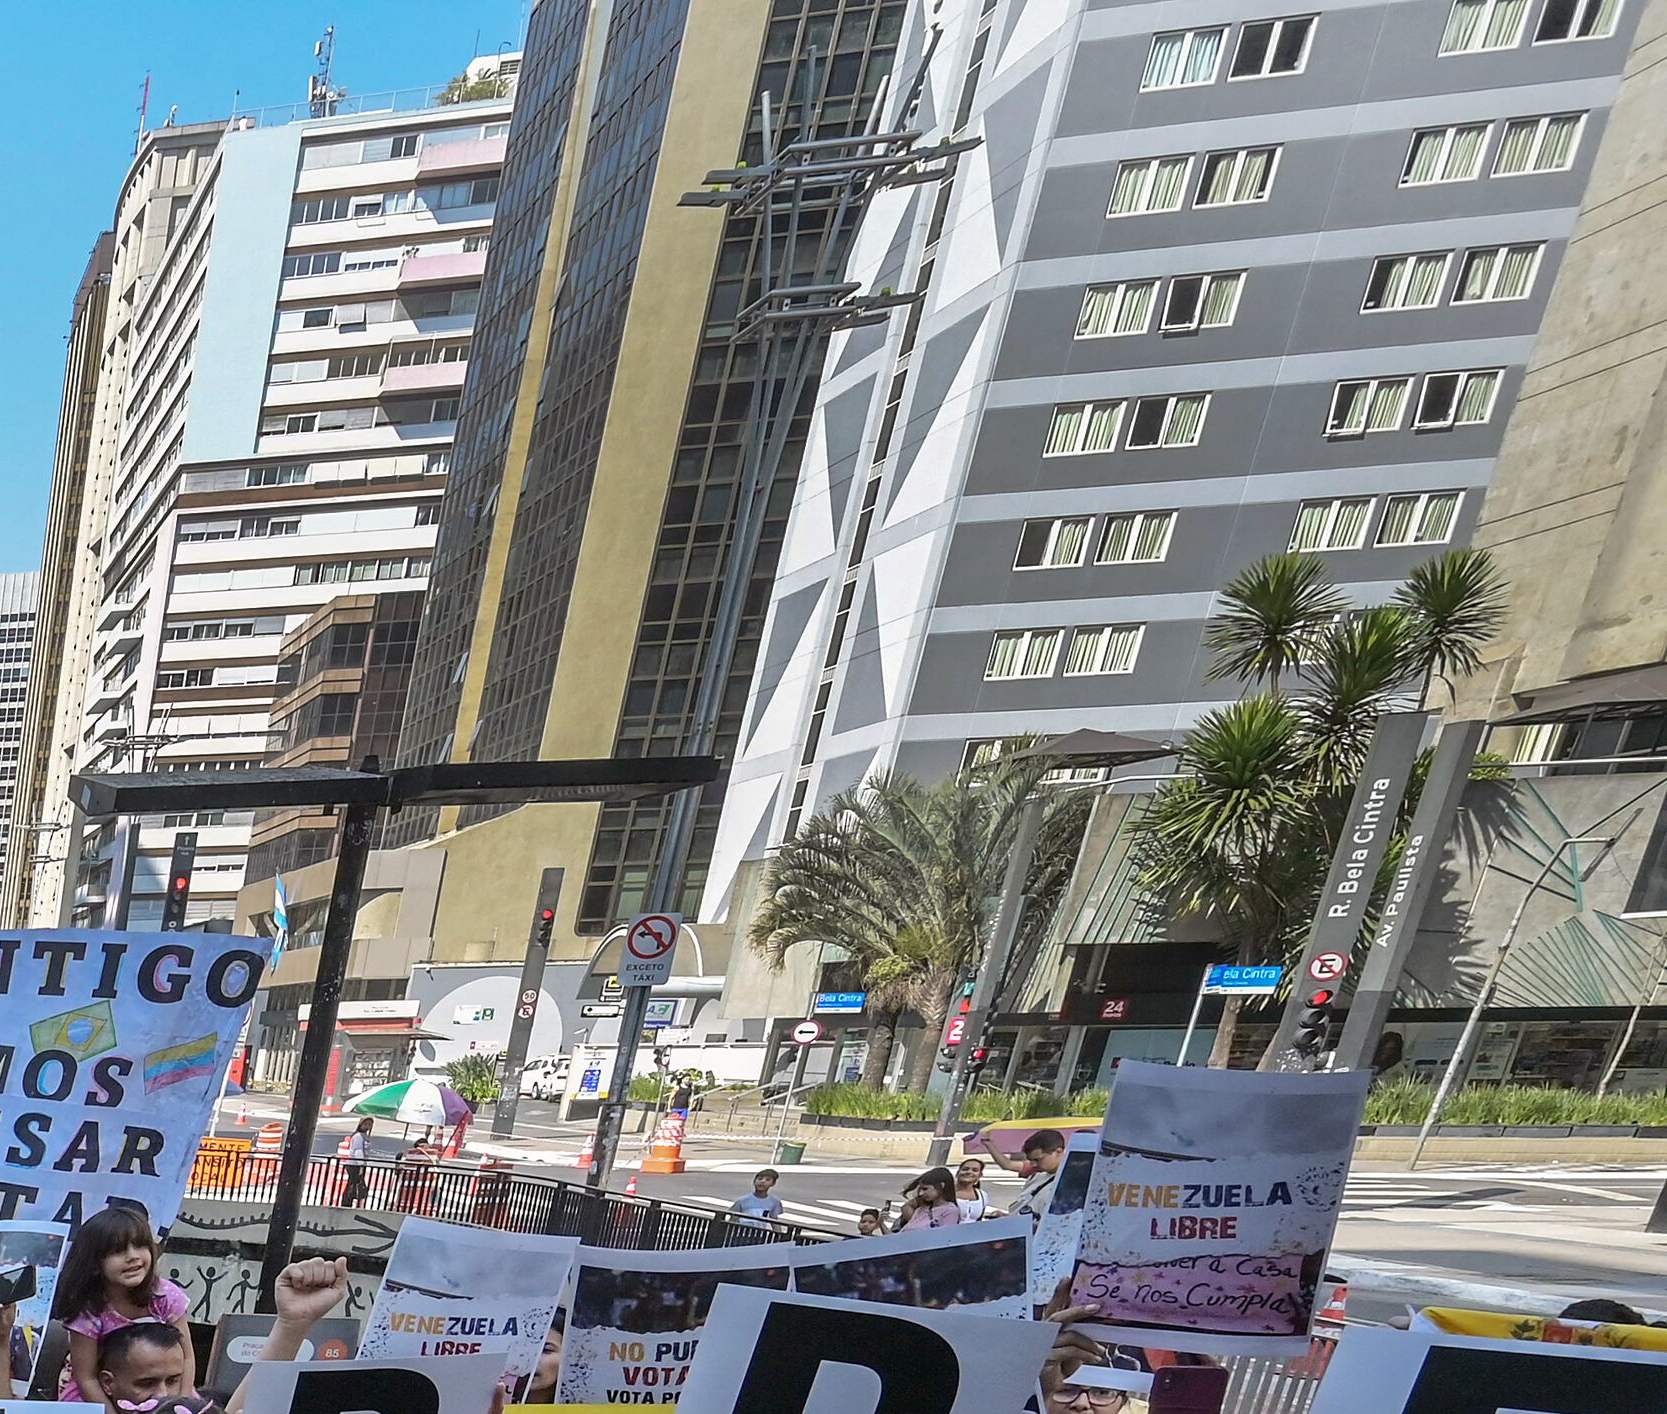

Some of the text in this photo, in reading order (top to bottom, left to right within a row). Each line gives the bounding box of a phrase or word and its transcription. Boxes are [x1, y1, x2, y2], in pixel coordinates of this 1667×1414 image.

[1328, 777, 1391, 917] R. Bela Cintra
[1376, 834, 1424, 947] Av. Paulista
[625, 963, 664, 972] EXCETO
[1242, 967, 1277, 980] Cintra
[1103, 1000, 1125, 1013] 24
[1107, 1182, 1293, 1209] VENEZUELA
[1149, 1215, 1238, 1242] LIBRE
[1134, 1285, 1181, 1305] nos
[1186, 1285, 1295, 1315] Cumpla
[390, 1311, 519, 1337] VENEZUELA
[325, 1348, 339, 1358] 85
[609, 1341, 646, 1362] NO
[623, 1364, 690, 1387] VOTA
[606, 1389, 652, 1404] VOTA
